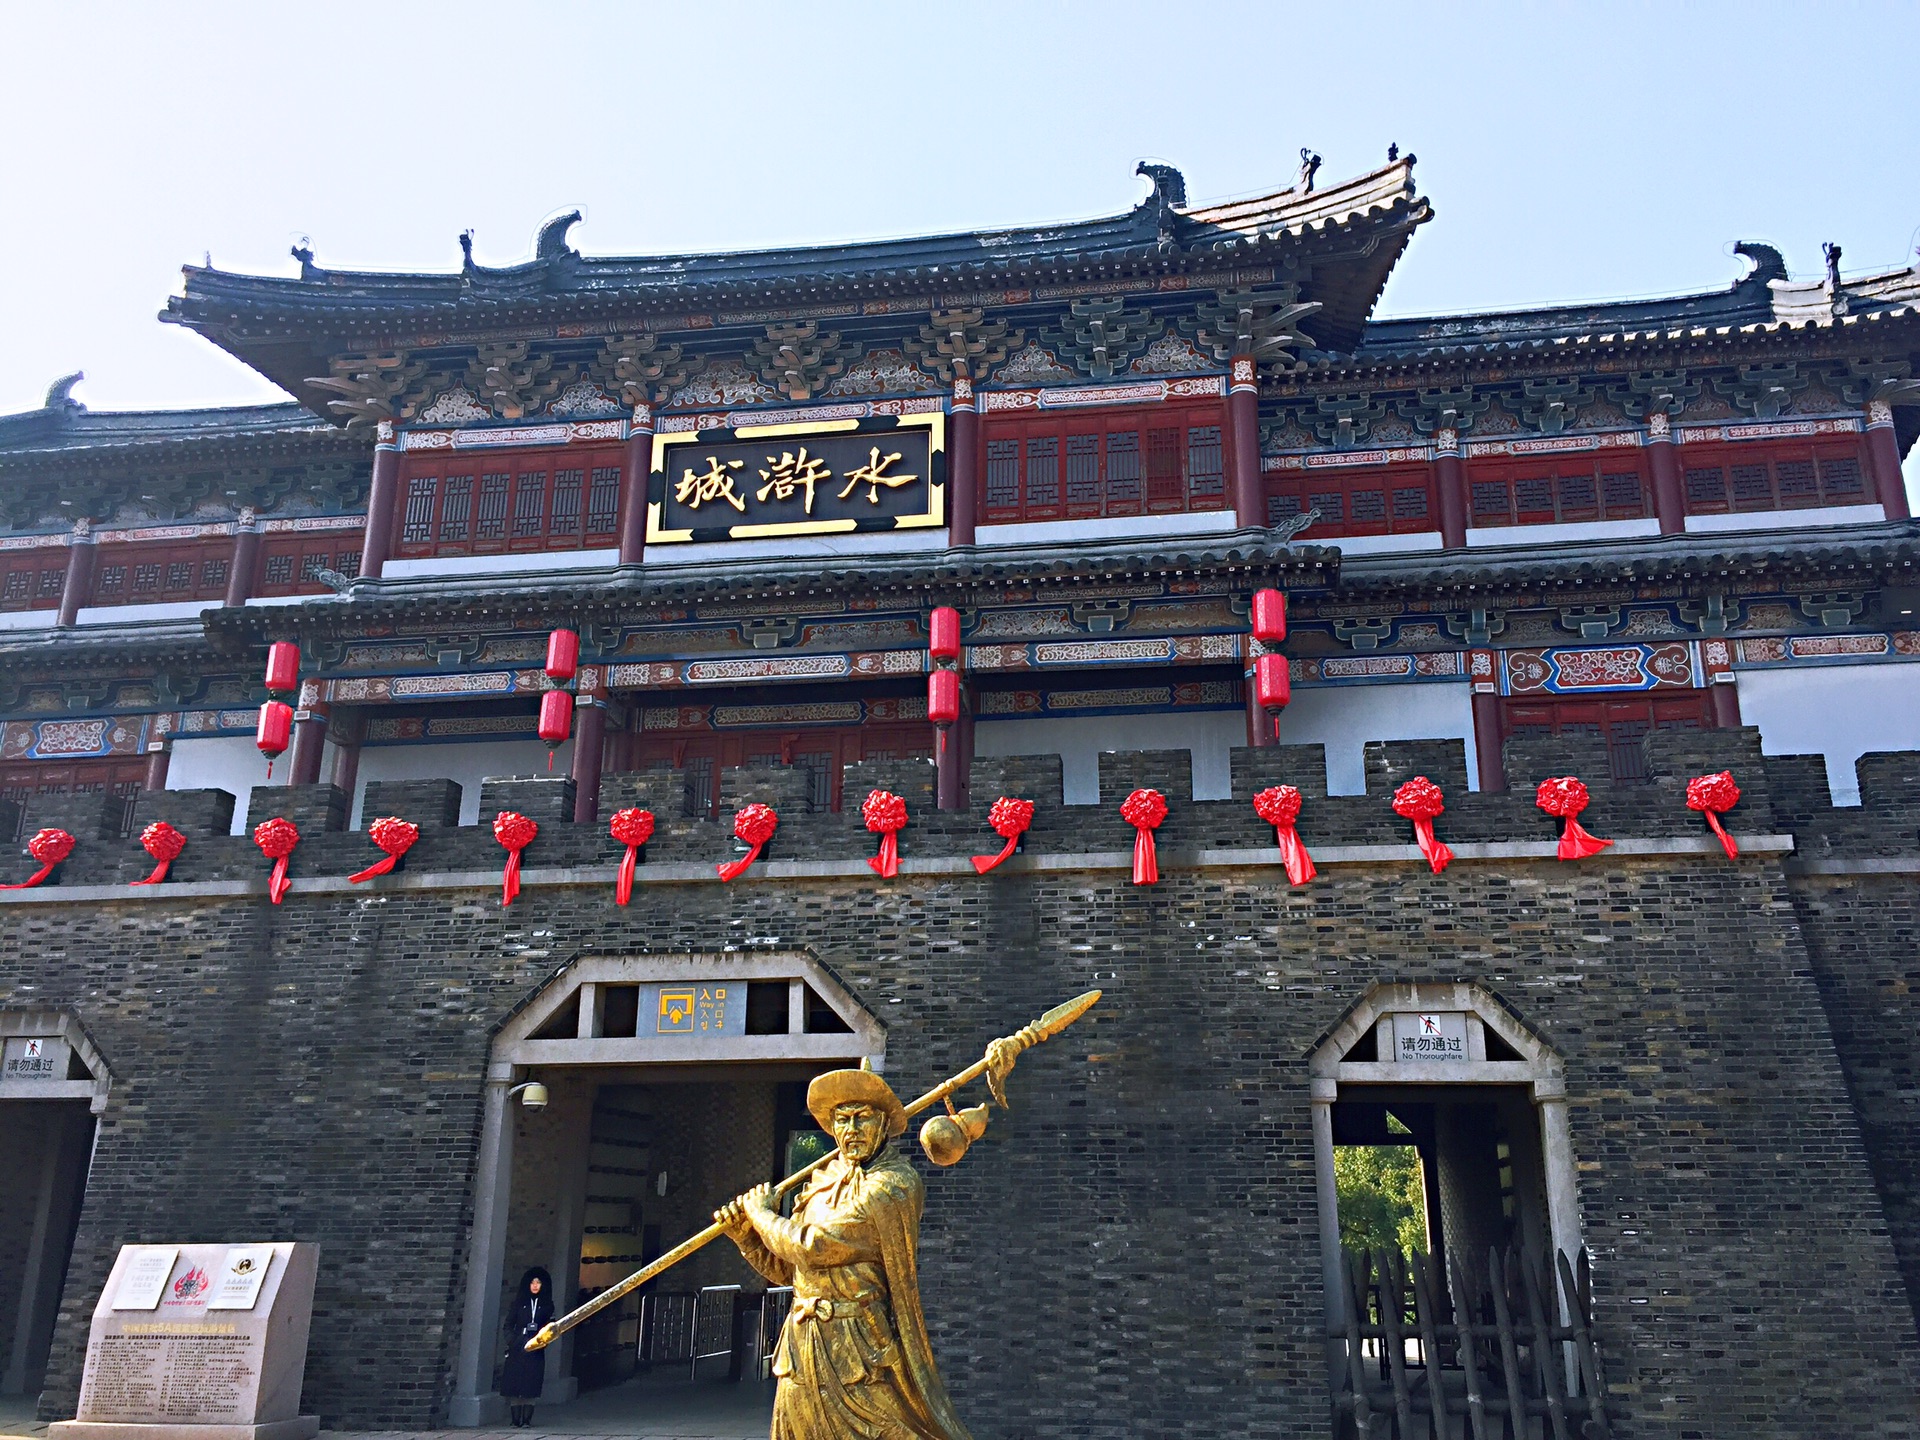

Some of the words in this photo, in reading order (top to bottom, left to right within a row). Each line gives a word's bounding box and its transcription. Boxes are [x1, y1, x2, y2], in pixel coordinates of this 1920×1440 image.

[700, 988, 726, 1001] 入口
[700, 1010, 724, 1019] 入口
[1401, 1037, 1462, 1052] 请勿通过
[1415, 1052, 1463, 1061] Thoroughfare
[7, 1058, 54, 1072] 请勿通过
